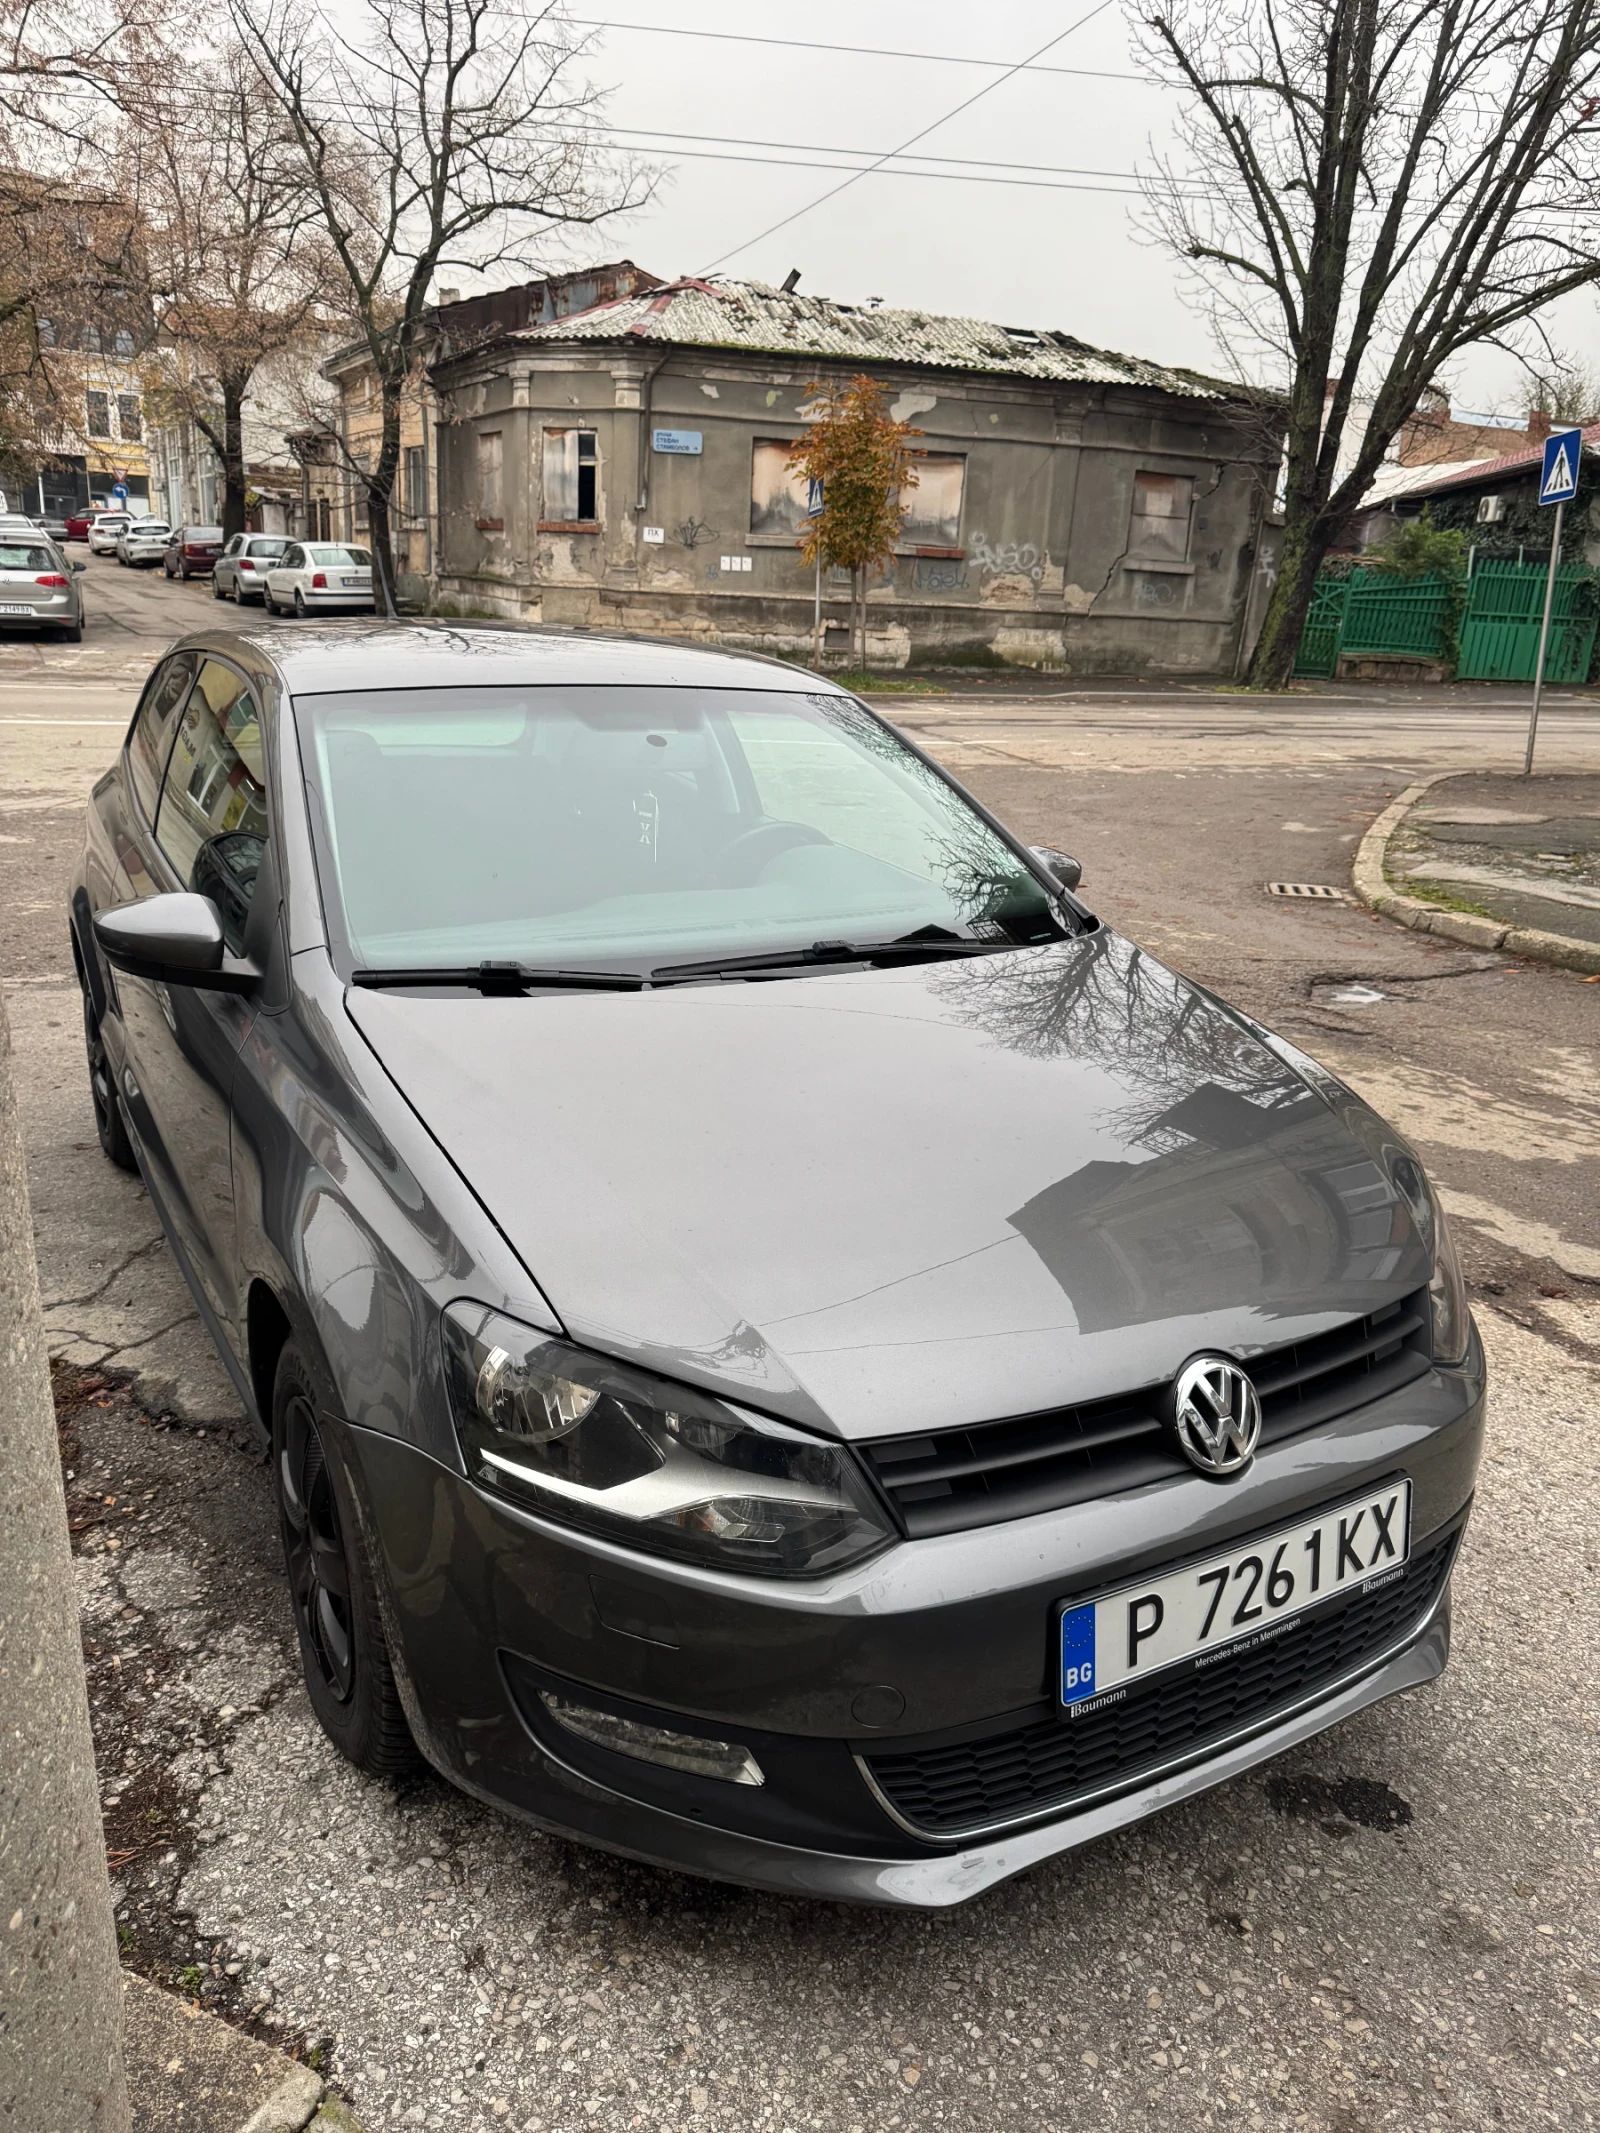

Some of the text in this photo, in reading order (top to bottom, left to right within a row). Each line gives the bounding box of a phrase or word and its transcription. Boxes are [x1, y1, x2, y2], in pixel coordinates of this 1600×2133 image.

[1365, 1569, 1404, 1592] Baumann
[1128, 1593, 1164, 1668] P
[1195, 1618, 1301, 1668] Mercedes-Benz in Memmingen
[1067, 1662, 1092, 1689] BG
[1074, 1689, 1127, 1717] Baumann
